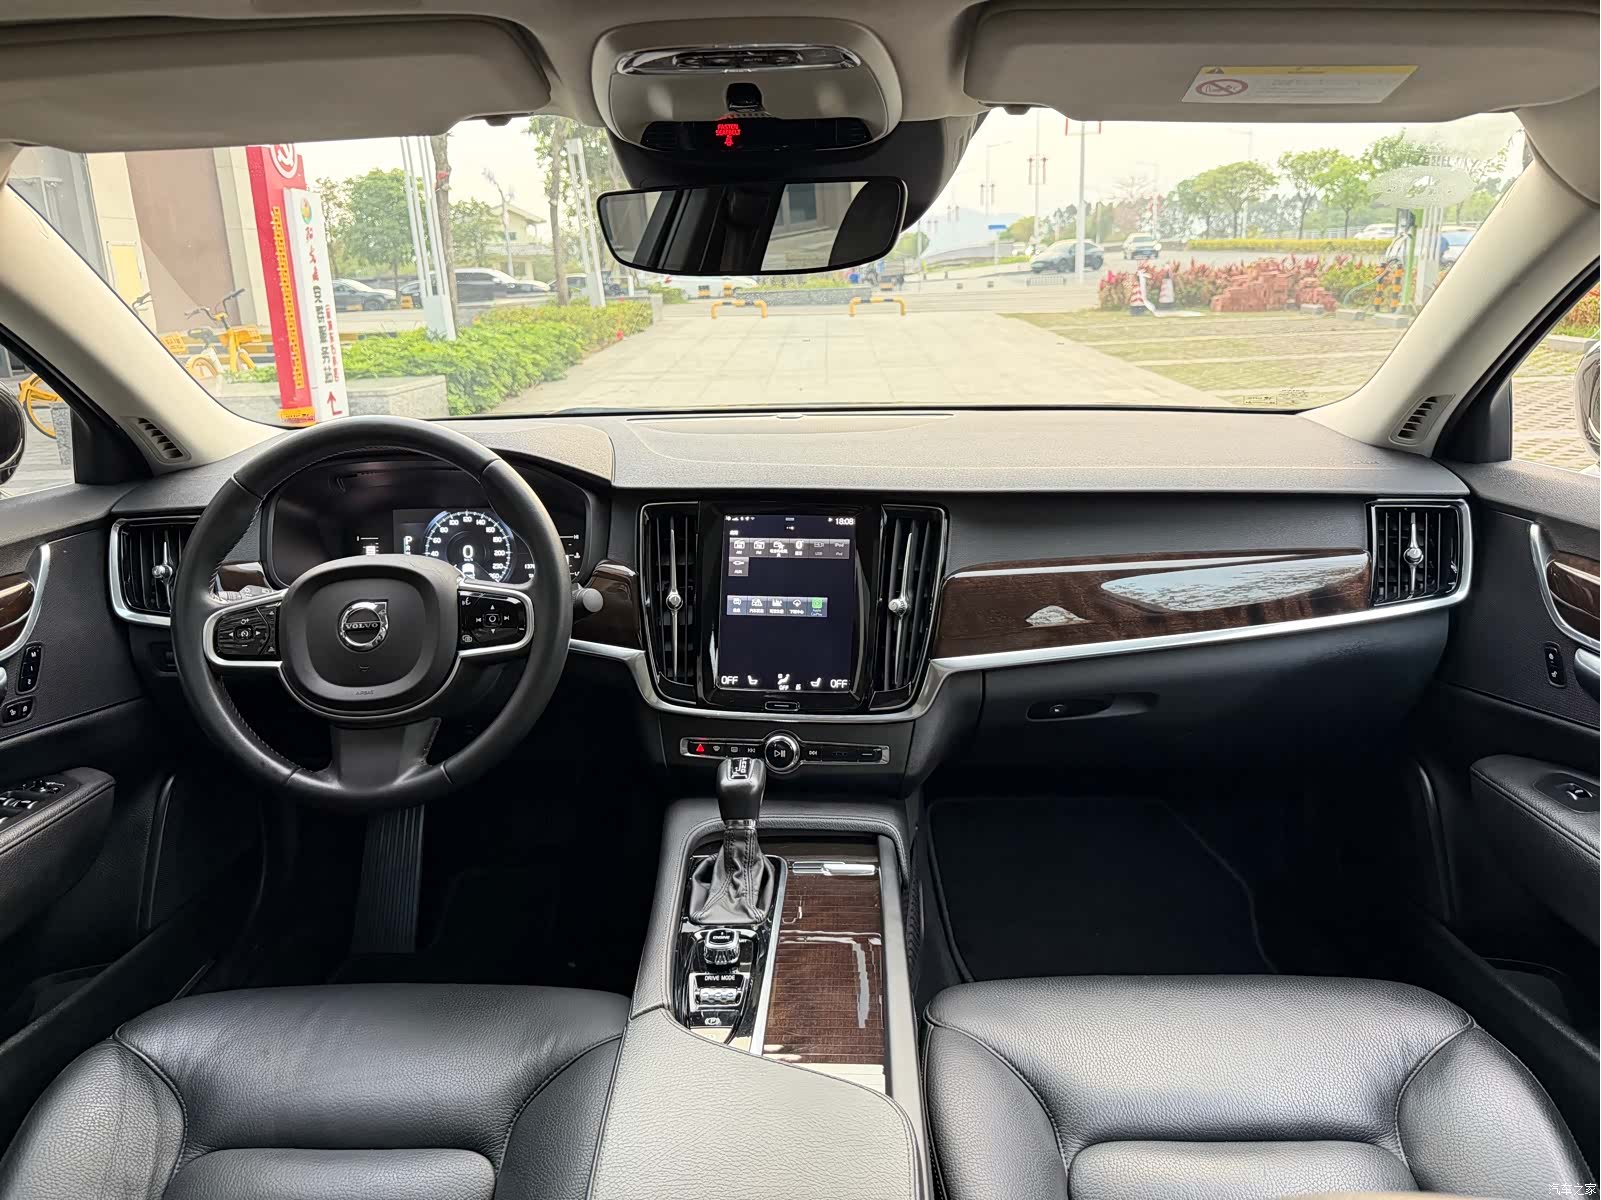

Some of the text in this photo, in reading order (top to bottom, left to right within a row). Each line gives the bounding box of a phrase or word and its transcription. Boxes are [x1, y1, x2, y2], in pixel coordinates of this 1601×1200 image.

[835, 517, 854, 526] 18:08
[462, 544, 474, 558] 0
[720, 675, 739, 685] OFF
[830, 679, 848, 688] OFF
